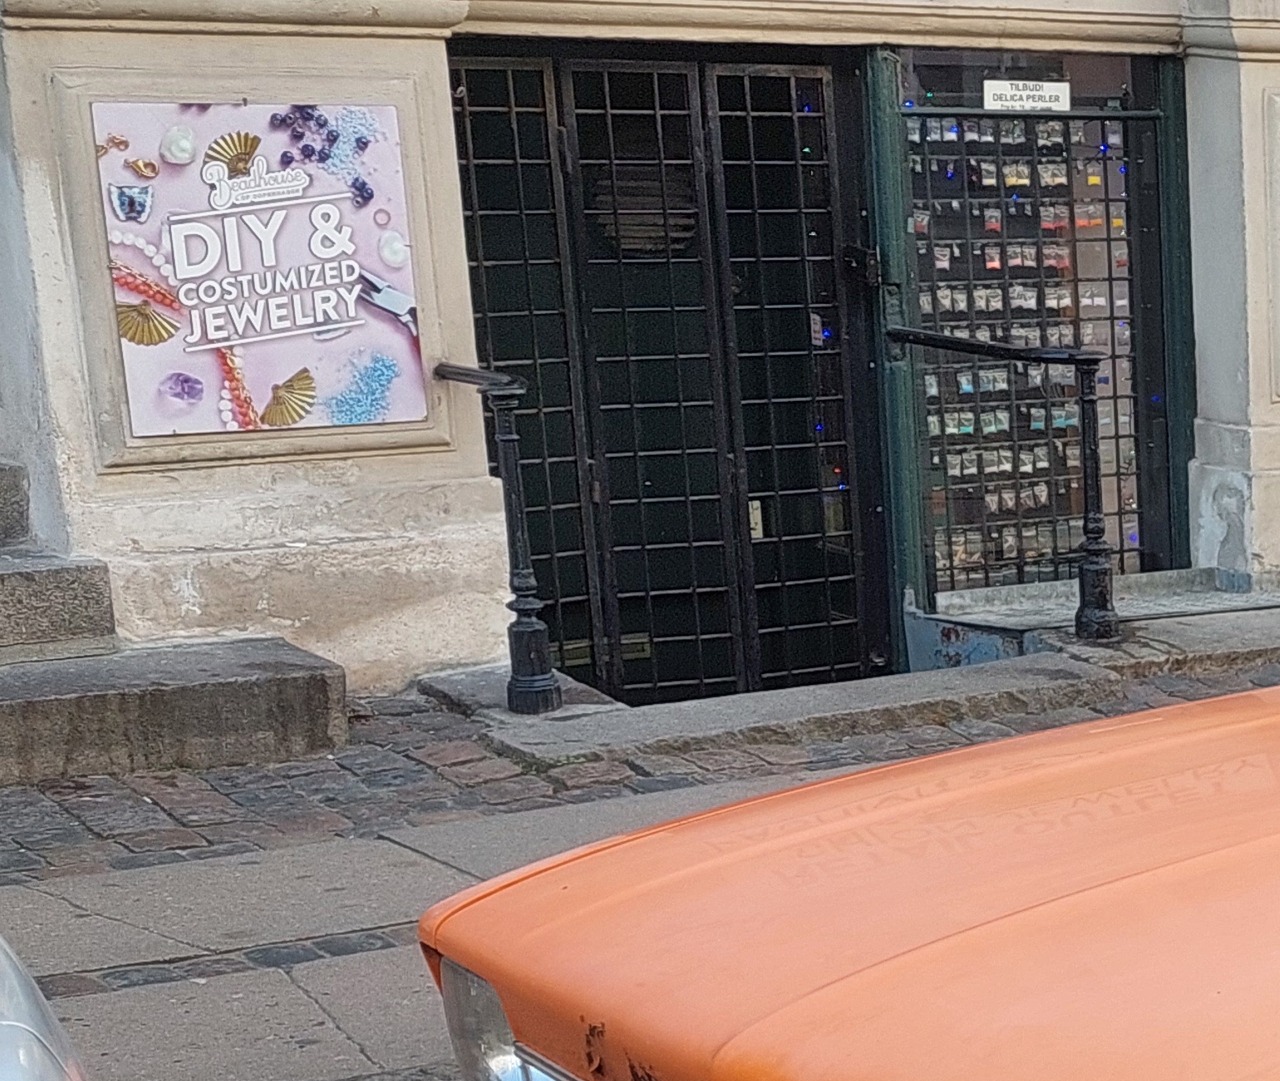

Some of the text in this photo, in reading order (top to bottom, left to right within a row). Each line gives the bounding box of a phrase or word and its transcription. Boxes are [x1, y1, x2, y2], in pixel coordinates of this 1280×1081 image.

[992, 93, 1061, 103] DELICA PERLER
[203, 157, 308, 209] Beadhouse
[170, 203, 357, 280] DIY &
[178, 260, 361, 306] COSTUMIZED
[184, 284, 363, 343] JEWELRY
